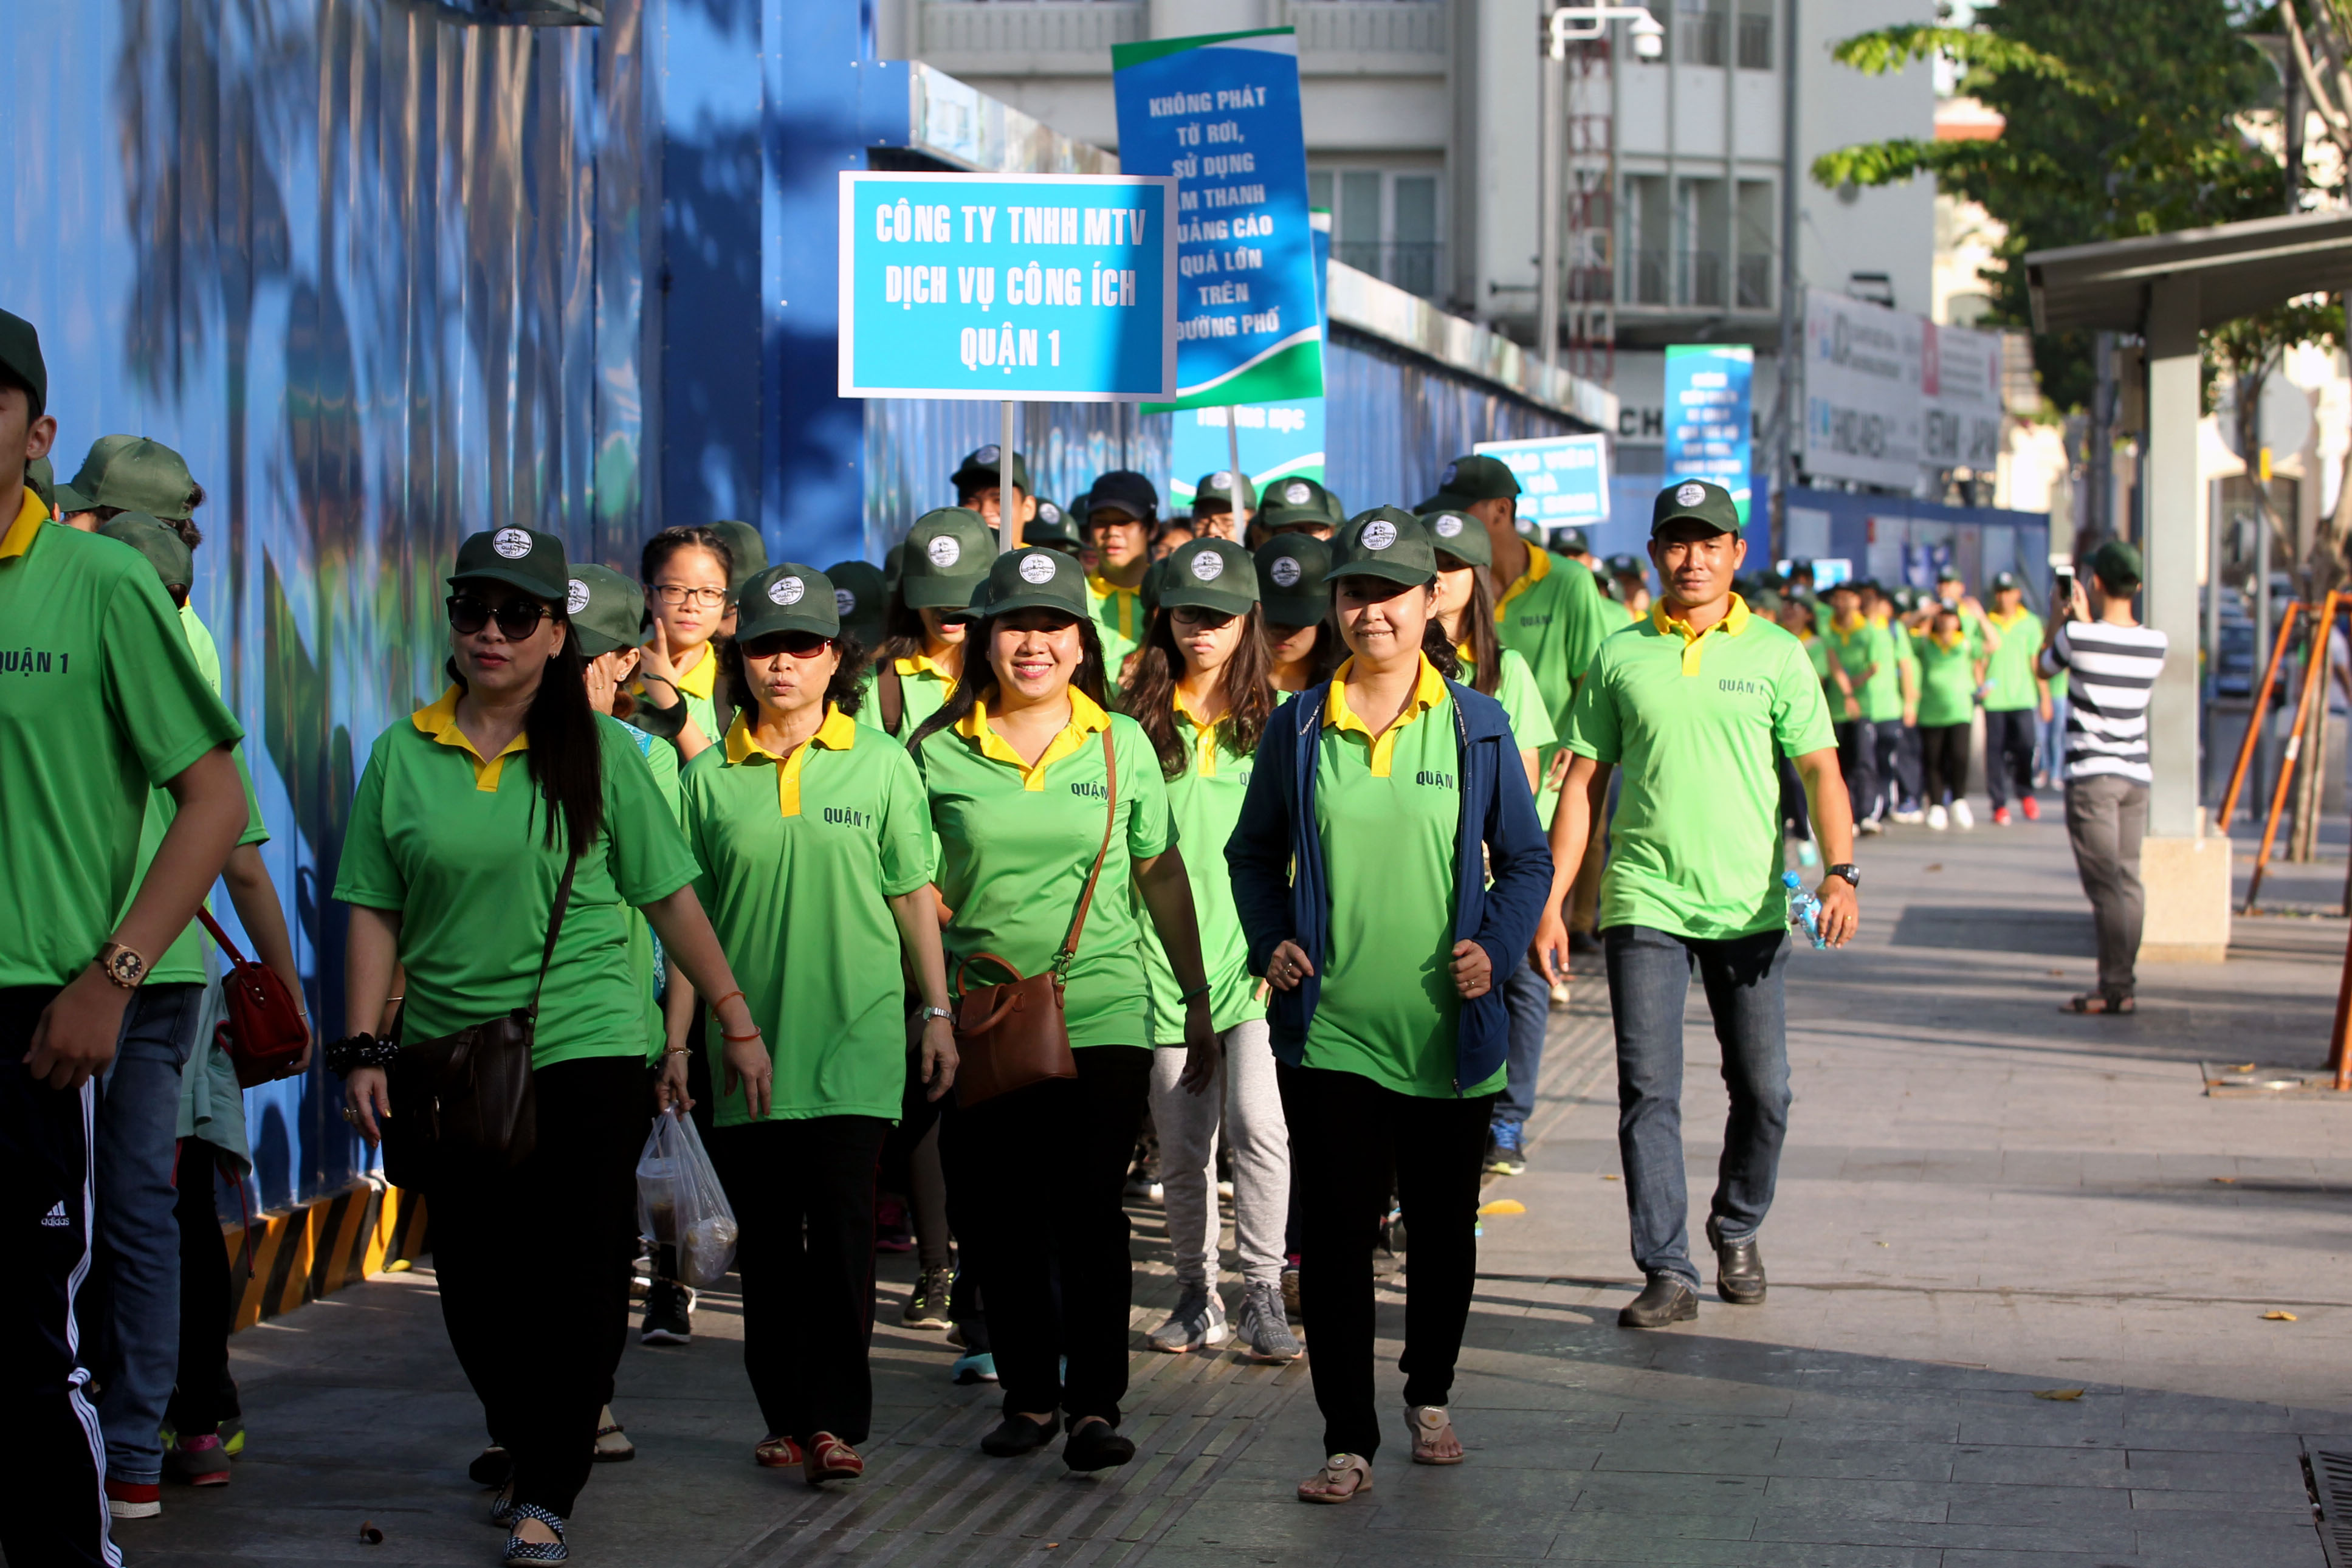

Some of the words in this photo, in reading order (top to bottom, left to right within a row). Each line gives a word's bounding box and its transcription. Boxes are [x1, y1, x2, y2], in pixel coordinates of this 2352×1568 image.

[1149, 92, 1212, 117] KHÔNG
[1217, 84, 1267, 110] PHÁT
[1177, 122, 1201, 146] TỜ
[1172, 151, 1198, 179] SỬ
[1203, 153, 1255, 179] DỤNG
[1178, 190, 1198, 211] M
[1203, 184, 1265, 208] THANH
[876, 198, 951, 242] CÔNG
[961, 205, 996, 243] TY
[1007, 207, 1078, 244] TNHH
[1084, 208, 1146, 246] MTV
[1177, 216, 1228, 243] UẢNG
[1233, 213, 1273, 239] CÁO
[1180, 249, 1219, 278] QUÁ
[1225, 246, 1262, 271] LỚN
[885, 265, 947, 310] DỊCH
[958, 267, 994, 311] VỤ
[1007, 261, 1082, 306] CÔNG
[1092, 261, 1136, 306] ÍCH
[1198, 280, 1250, 306] TRÊN
[1241, 306, 1280, 334] PHỐ
[960, 321, 1037, 374] QUẬN
[1048, 329, 1060, 366] 1
[60, 653, 69, 674] 1
[1719, 678, 1755, 695] QUẬN
[1071, 780, 1109, 800] QUẬN
[1416, 770, 1453, 789] QUẬN
[824, 806, 862, 828] QUẬN
[865, 814, 871, 830] 1
[41, 1217, 70, 1226] adidas
